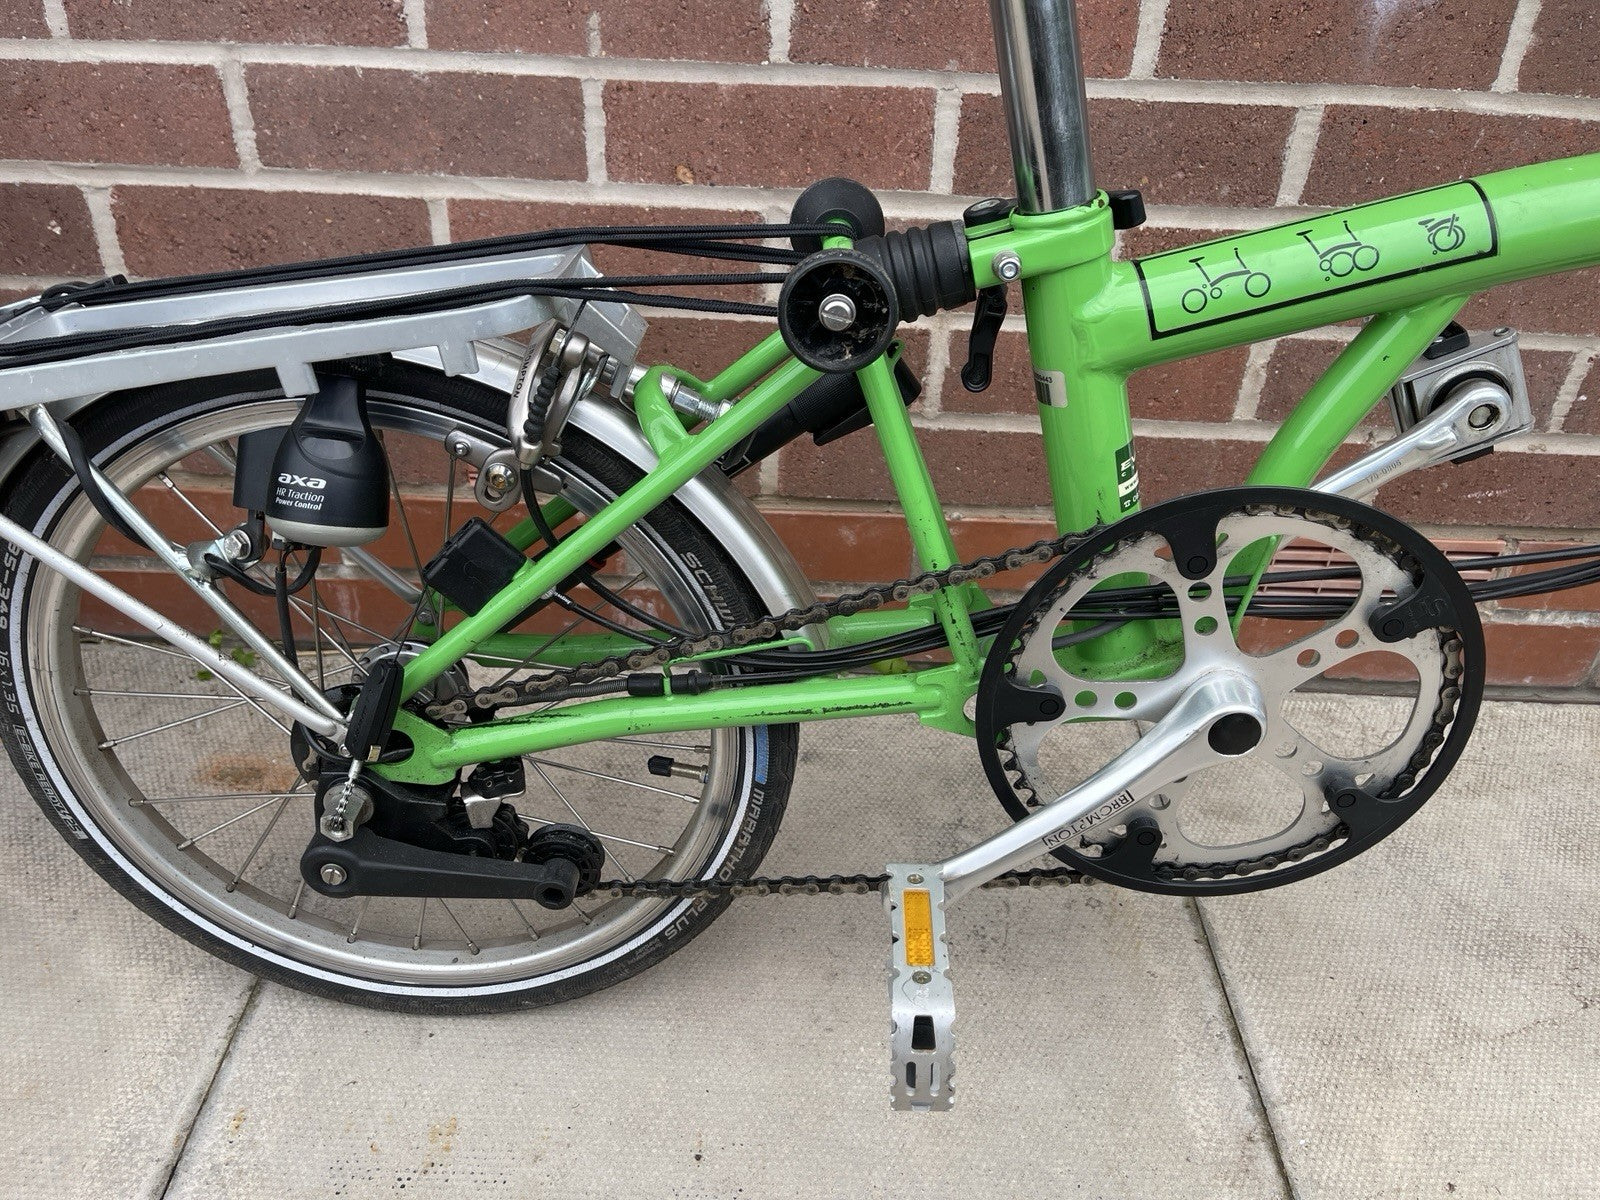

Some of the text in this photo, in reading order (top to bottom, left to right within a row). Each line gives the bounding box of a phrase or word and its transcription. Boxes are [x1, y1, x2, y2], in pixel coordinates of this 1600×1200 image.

[276, 486, 325, 503] HR Traction
[278, 472, 327, 489] axa
[275, 496, 323, 511] Power Control
[680, 551, 736, 627] SCHW
[35, 772, 63, 812] READY
[664, 787, 766, 941] MARATHO PLUS
